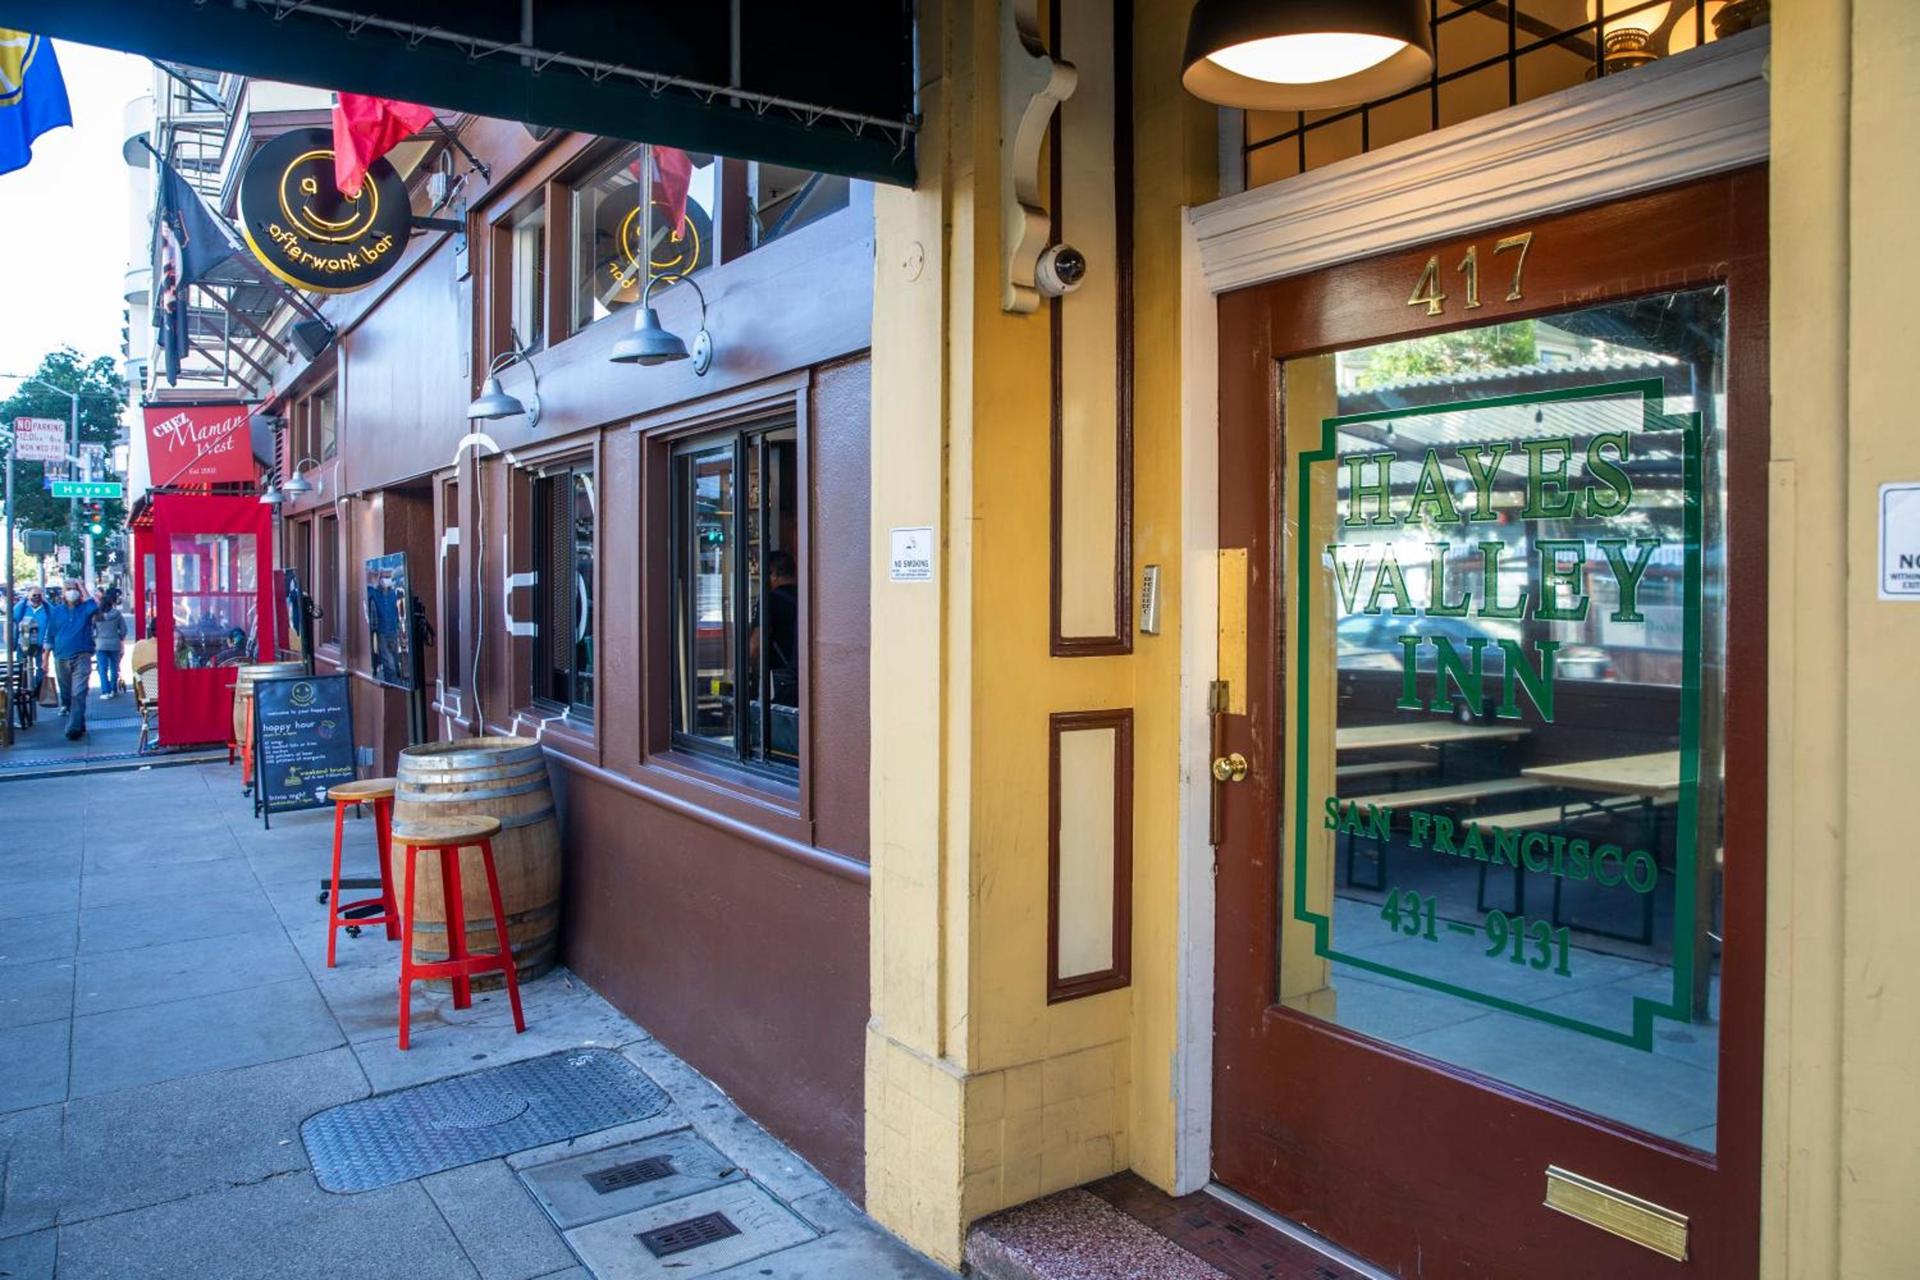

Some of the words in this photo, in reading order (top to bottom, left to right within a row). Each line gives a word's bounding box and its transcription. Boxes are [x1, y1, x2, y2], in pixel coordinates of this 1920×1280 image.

[268, 222, 361, 272] afterwork
[360, 234, 393, 264] bar
[1407, 230, 1536, 317] 417
[17, 419, 32, 431] NO
[32, 423, 65, 433] PARKING
[153, 411, 190, 438] CHEZ
[168, 414, 243, 453] Maman
[196, 434, 235, 457] West
[64, 485, 112, 497] Hayes
[1343, 430, 1634, 528] HAYES
[1326, 538, 1661, 624] VALLEY
[1396, 634, 1561, 724] INN
[263, 723, 291, 734] happy
[295, 720, 316, 729] hour
[1323, 795, 1392, 843] SAN
[1408, 809, 1659, 895] FRANCISCO
